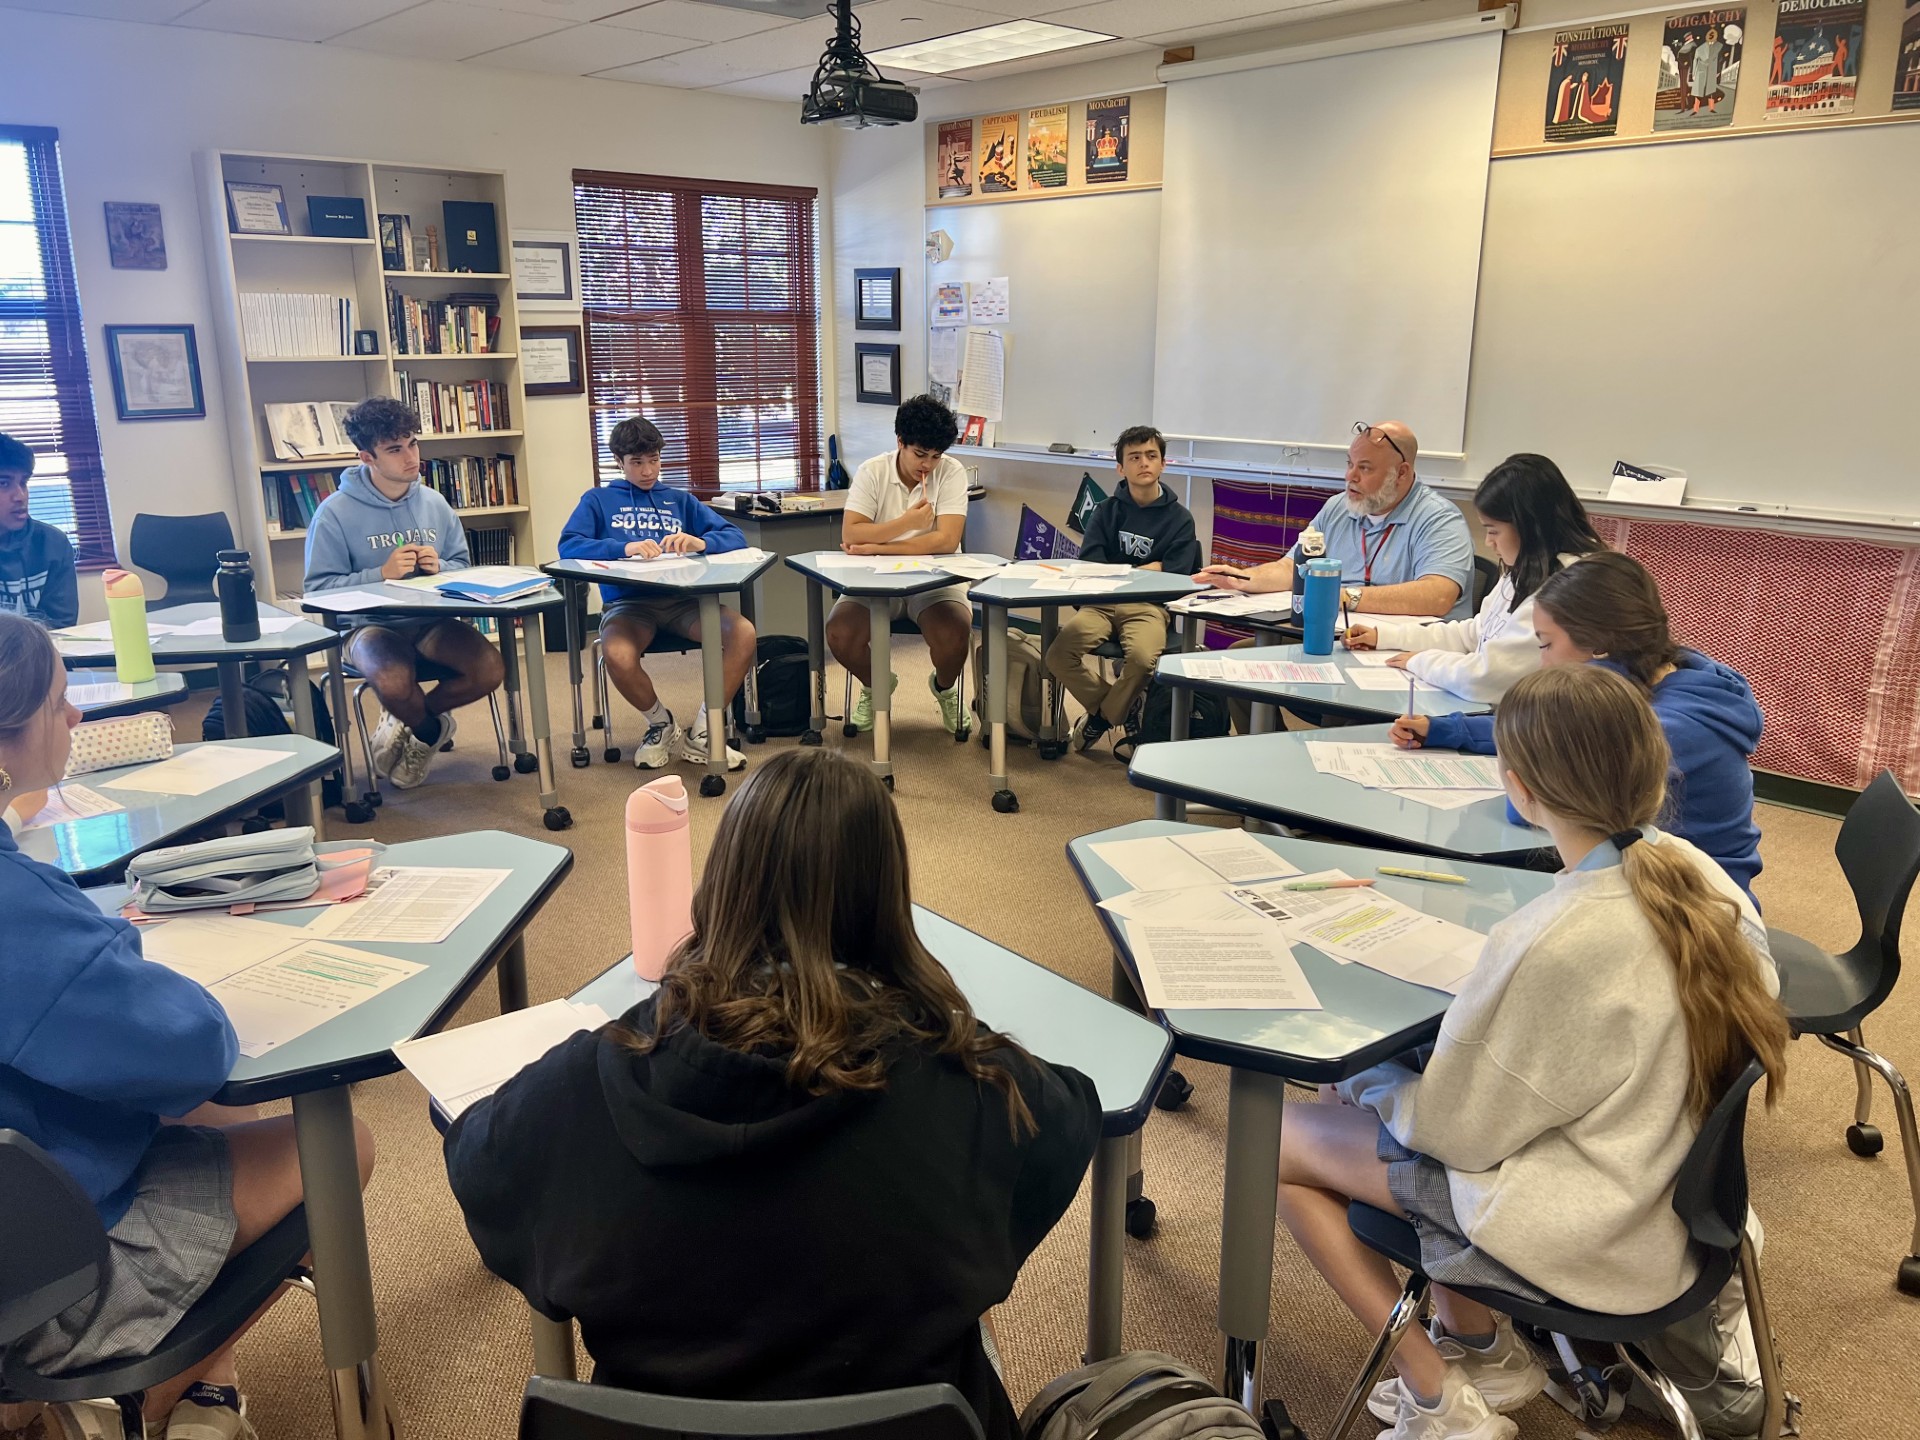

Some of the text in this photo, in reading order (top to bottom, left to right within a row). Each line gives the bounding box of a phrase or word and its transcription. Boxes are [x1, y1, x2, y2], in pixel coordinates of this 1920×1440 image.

[1780, 0, 1864, 13] DEMOCR
[1668, 10, 1741, 29] OLIGARCHY
[1556, 25, 1628, 43] CONSTITUTIONAL
[1088, 98, 1127, 110] MONARCHY
[1030, 106, 1067, 119] FEUDALISM
[938, 121, 971, 131] COMMUNISM
[982, 114, 1017, 125] CAPITALISM
[611, 513, 682, 533] SOCCER
[367, 528, 437, 549] TROJANS
